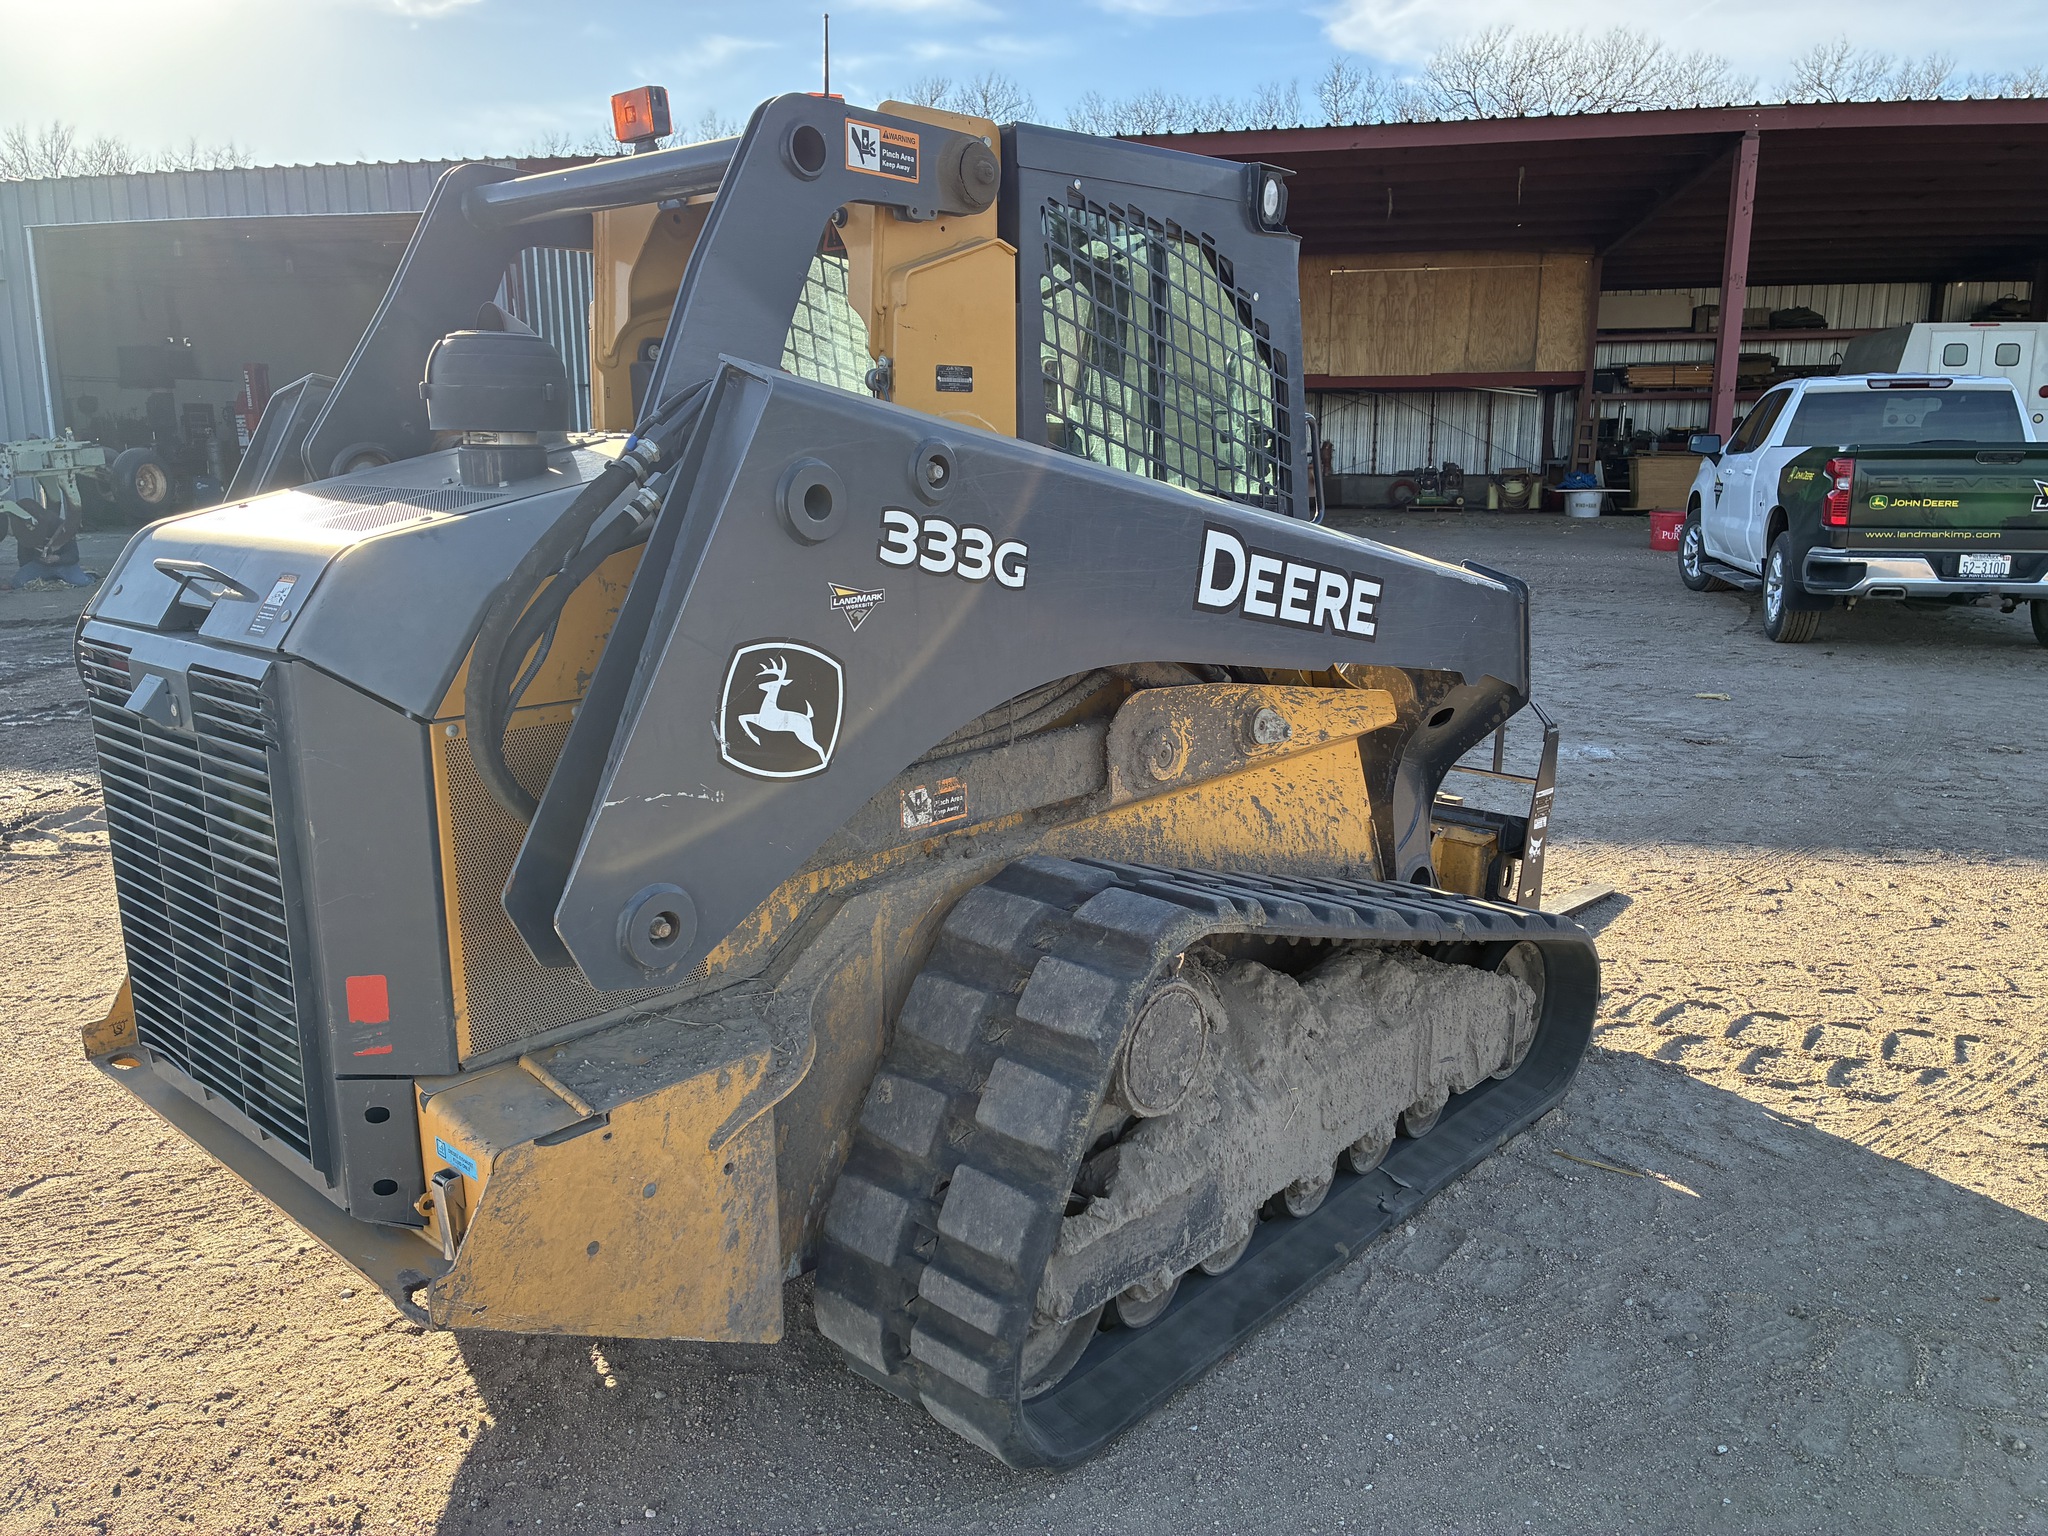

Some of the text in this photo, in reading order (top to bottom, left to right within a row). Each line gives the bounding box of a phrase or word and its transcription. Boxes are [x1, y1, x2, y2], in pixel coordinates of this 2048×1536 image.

[889, 133, 915, 144] WARNING
[882, 149, 914, 162] Pinch Area
[882, 160, 910, 172] Keep Away
[1890, 498, 1960, 508] JOHN DEERE
[1865, 530, 2001, 539] www.landmarkimp.com
[878, 509, 1029, 589] 333G
[1197, 529, 1382, 637] DEERE
[833, 592, 883, 606] LANDMARK
[845, 601, 874, 610] WORKSITE
[933, 798, 949, 807] Pch
